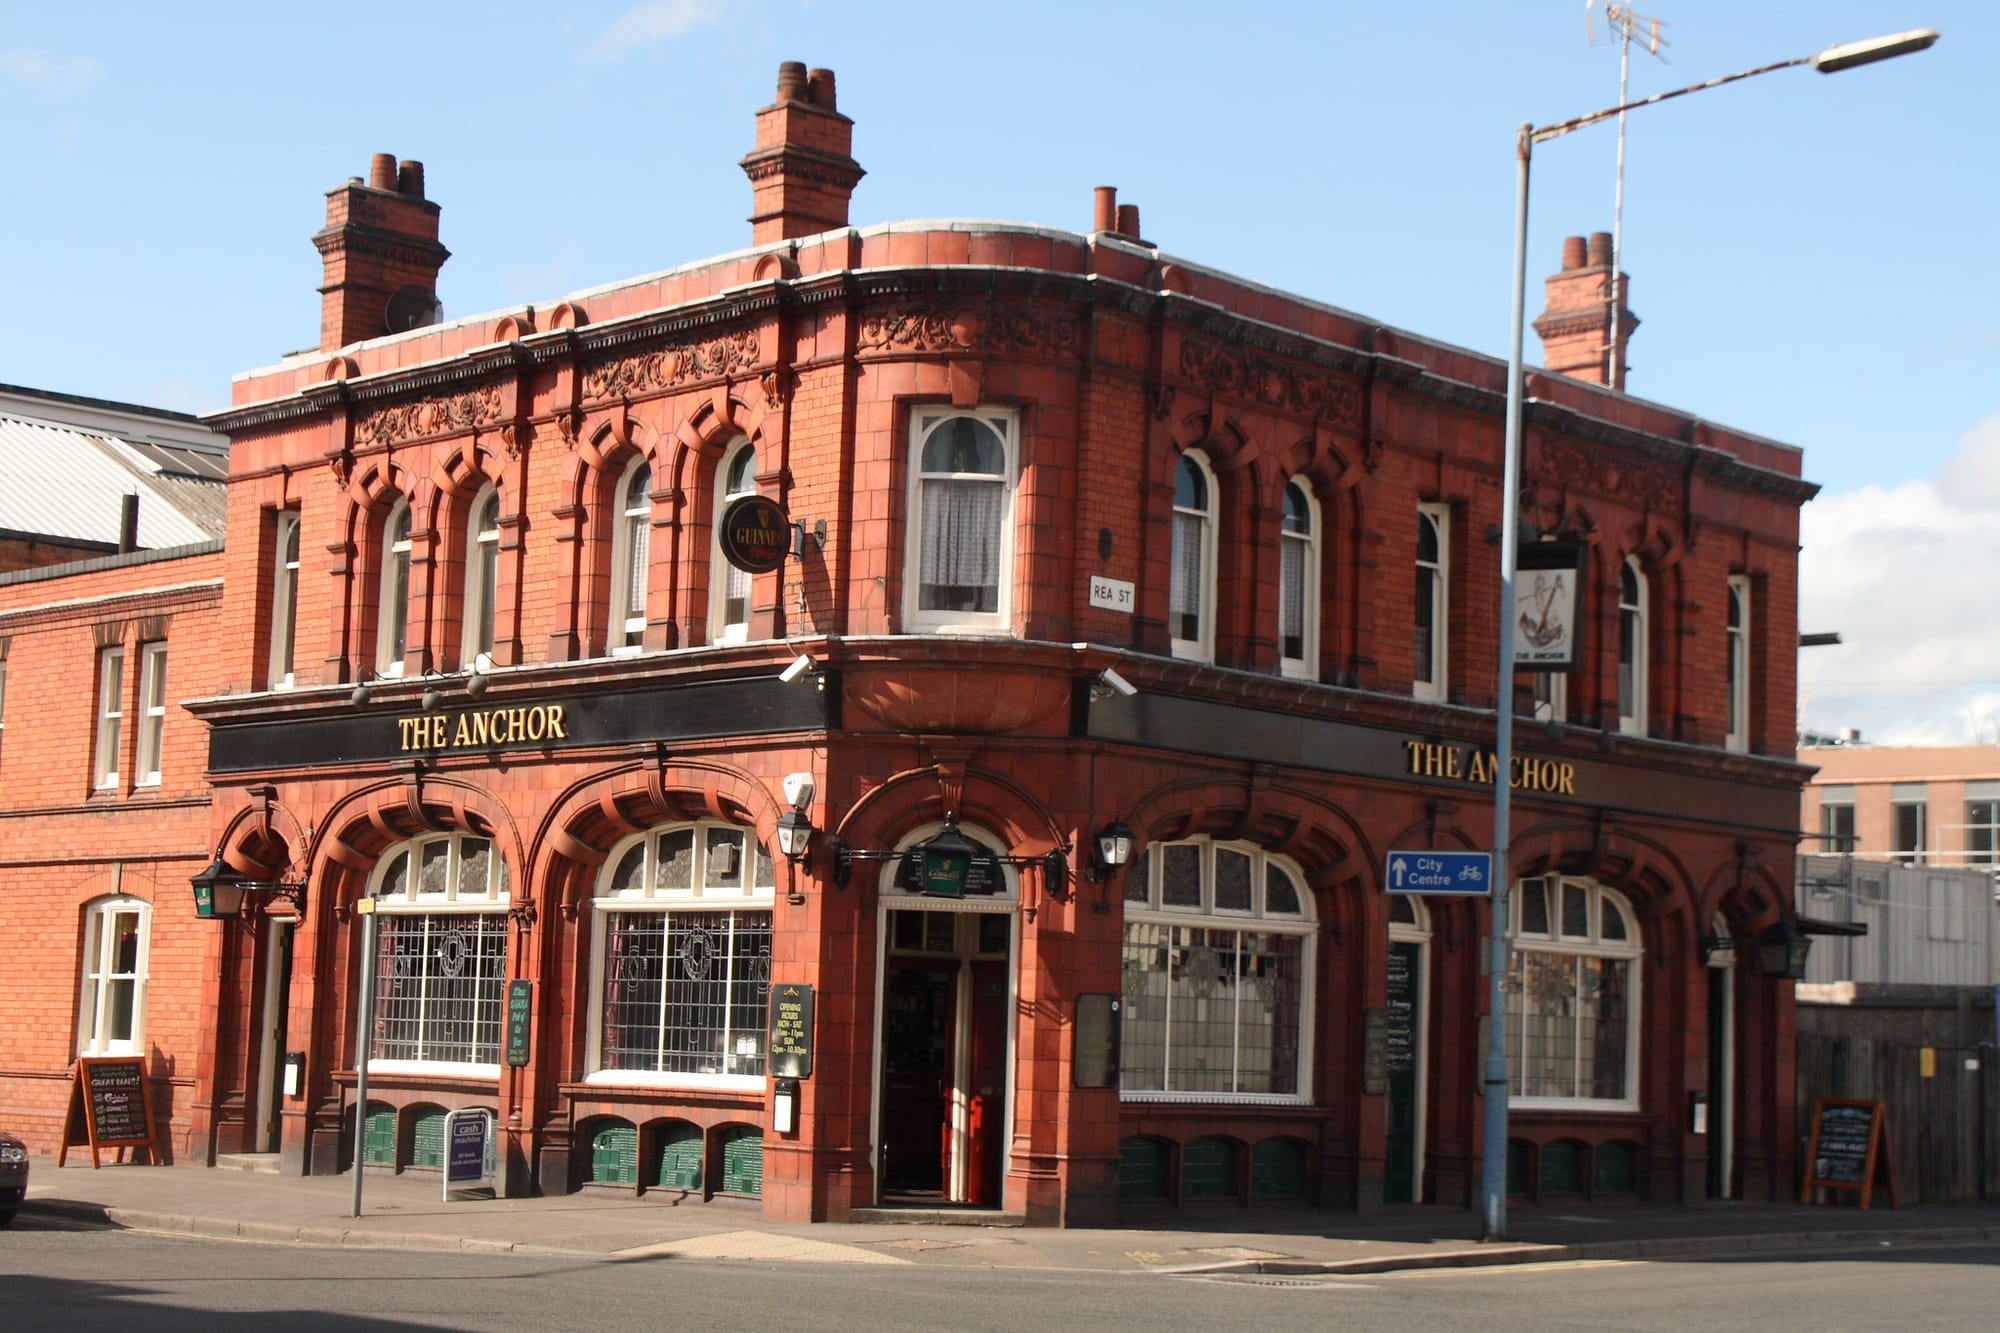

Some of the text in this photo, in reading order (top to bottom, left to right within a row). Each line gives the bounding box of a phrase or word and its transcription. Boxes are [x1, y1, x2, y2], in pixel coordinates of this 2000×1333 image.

[1094, 585, 1130, 603] REA ST
[399, 705, 567, 750] THE ANCHOR
[1408, 741, 1461, 779] THE
[1416, 858, 1443, 873] City
[1408, 872, 1451, 885] Centre
[779, 1003, 801, 1012] OPENING
[781, 1012, 798, 1020] HOURS
[777, 1020, 789, 1028] MON
[793, 1020, 802, 1029] SAT
[783, 1037, 794, 1045] SUN
[460, 1124, 479, 1134] cash
[455, 1136, 480, 1144] machine
